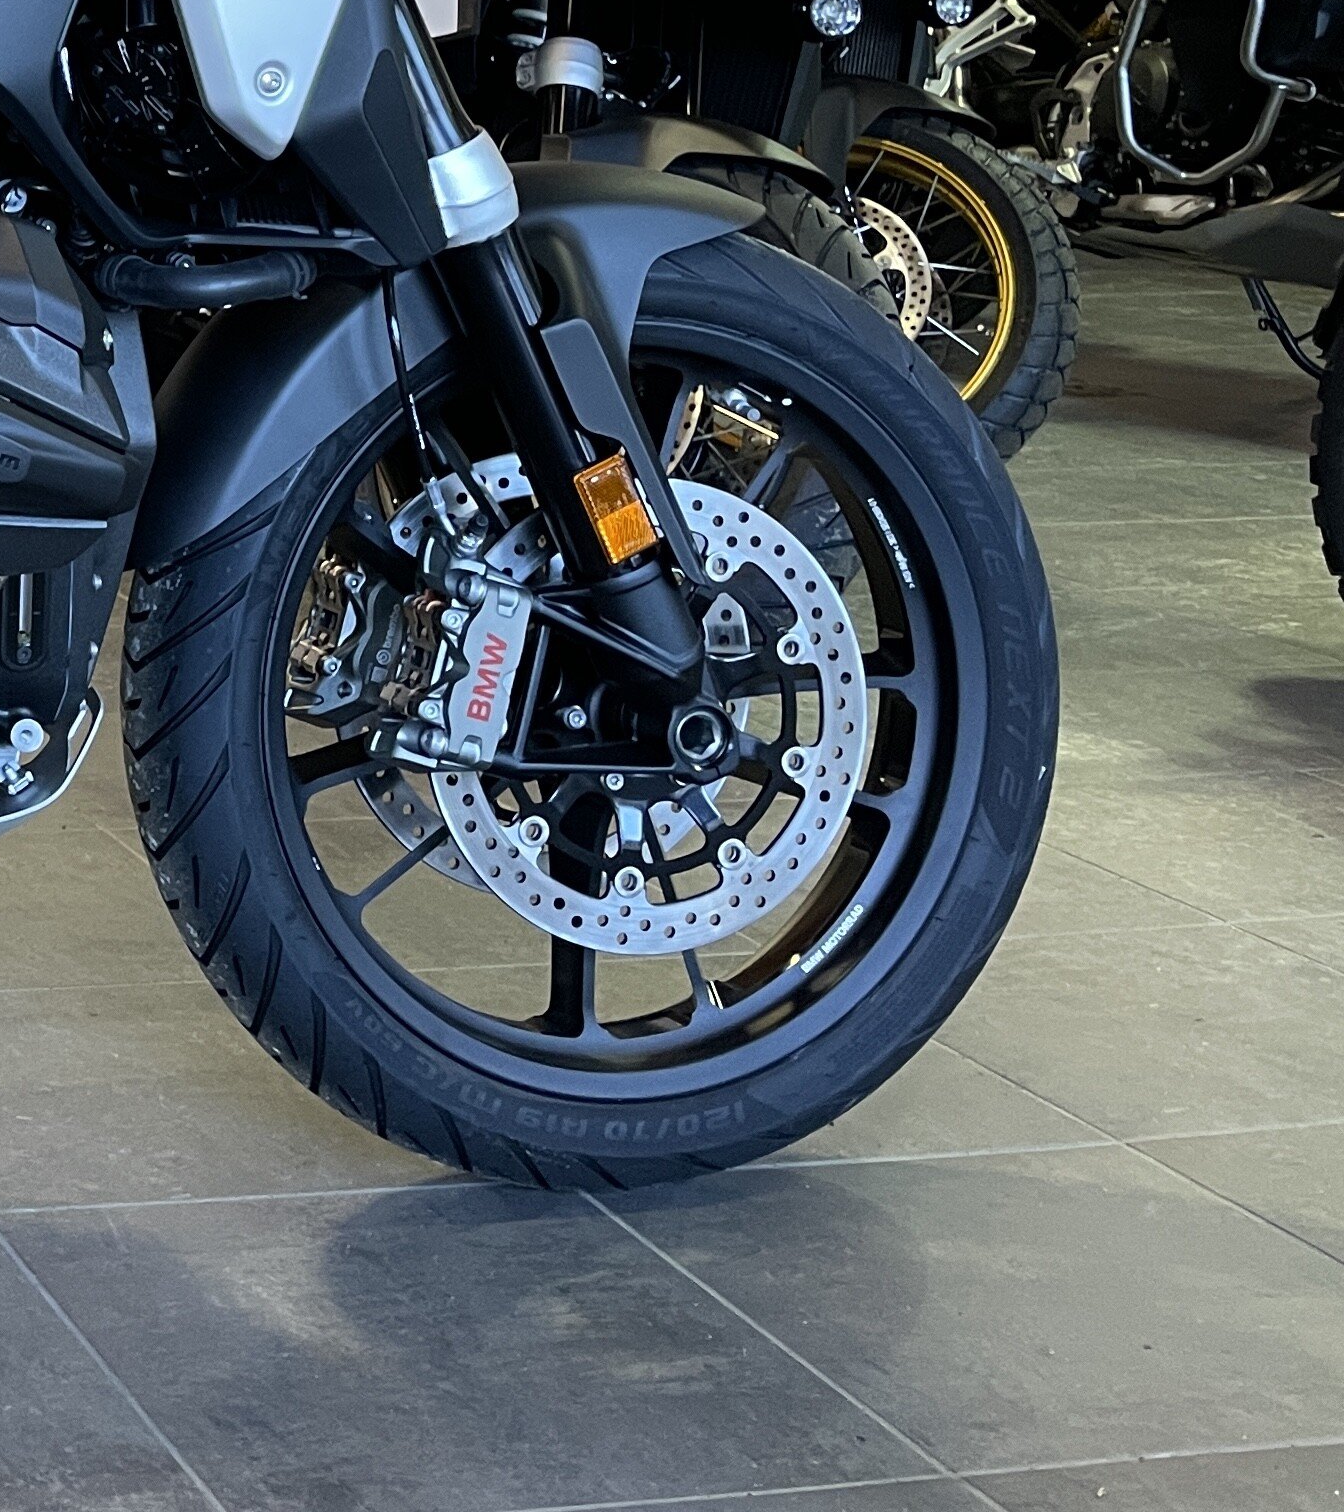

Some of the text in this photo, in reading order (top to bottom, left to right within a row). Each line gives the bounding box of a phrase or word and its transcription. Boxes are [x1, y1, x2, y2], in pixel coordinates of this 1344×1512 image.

[466, 632, 508, 722] BMW
[800, 903, 864, 974] BMW MOTORRAD
[602, 1099, 748, 1143] 120/70
